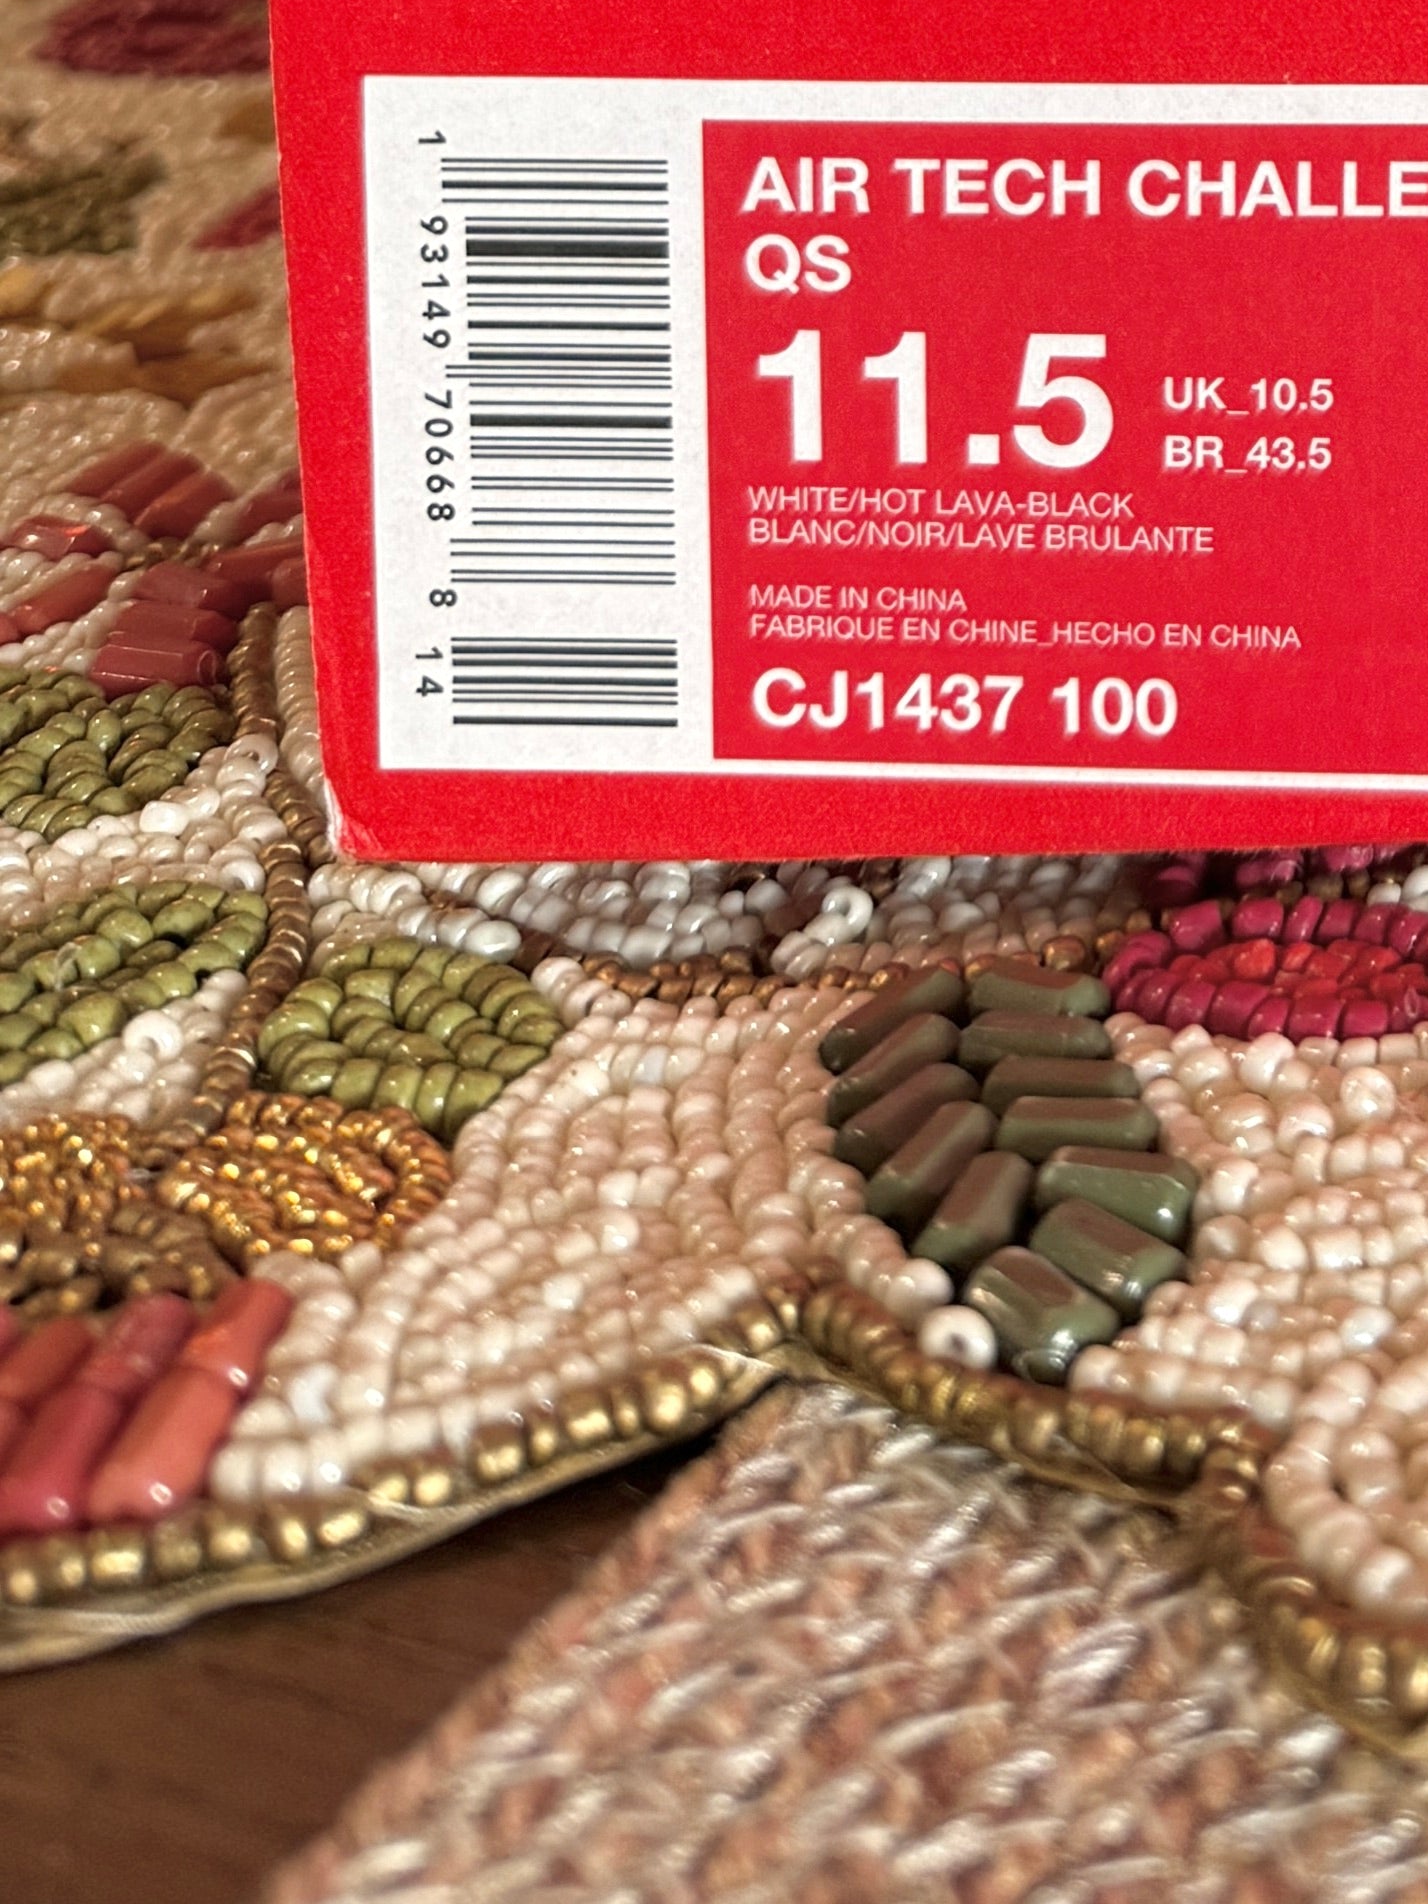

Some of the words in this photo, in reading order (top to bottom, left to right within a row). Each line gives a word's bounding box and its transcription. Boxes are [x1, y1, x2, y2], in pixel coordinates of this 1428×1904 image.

[417, 130, 446, 146] 1
[741, 157, 869, 213] AIR
[893, 159, 1100, 216] TECH
[421, 215, 449, 349] 93149
[744, 234, 851, 294] QS
[757, 330, 1113, 469] 11.5
[1164, 377, 1333, 414] UK_10.5
[426, 390, 453, 520] 70668
[1164, 436, 1331, 473] BR_43.5
[750, 489, 925, 512] WHITE/HOT
[936, 491, 1133, 518] LAVA-BLACK
[750, 520, 1038, 546] BLANC/NOIR/LAVE
[1045, 517, 1213, 551] BRULANTE
[429, 589, 457, 608] 8
[751, 585, 830, 608] MADE
[841, 588, 867, 609] IN
[877, 588, 966, 610] CHINA
[751, 614, 893, 639] FABRIQUE
[903, 618, 939, 640] EN
[1164, 624, 1201, 646] EN
[1211, 625, 1302, 647] CHINA
[415, 646, 444, 697] 14
[752, 668, 1023, 732] CJ1437
[1052, 678, 1177, 737] 100
